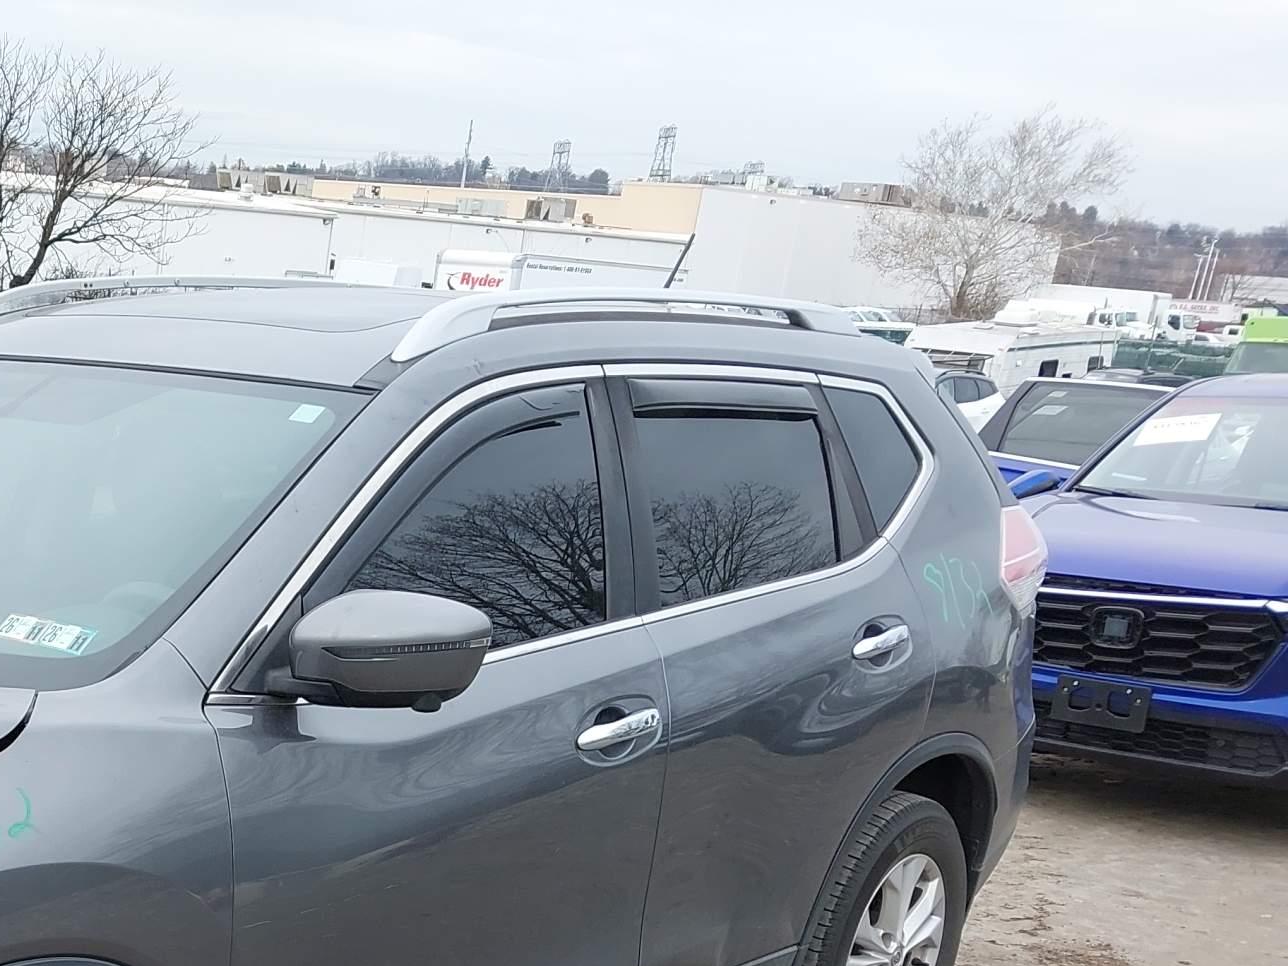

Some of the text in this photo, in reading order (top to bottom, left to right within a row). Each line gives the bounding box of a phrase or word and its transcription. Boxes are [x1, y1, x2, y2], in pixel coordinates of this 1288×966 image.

[459, 271, 505, 290] Ryder
[0, 616, 44, 641] 26 11
[42, 625, 89, 652] 26 11
